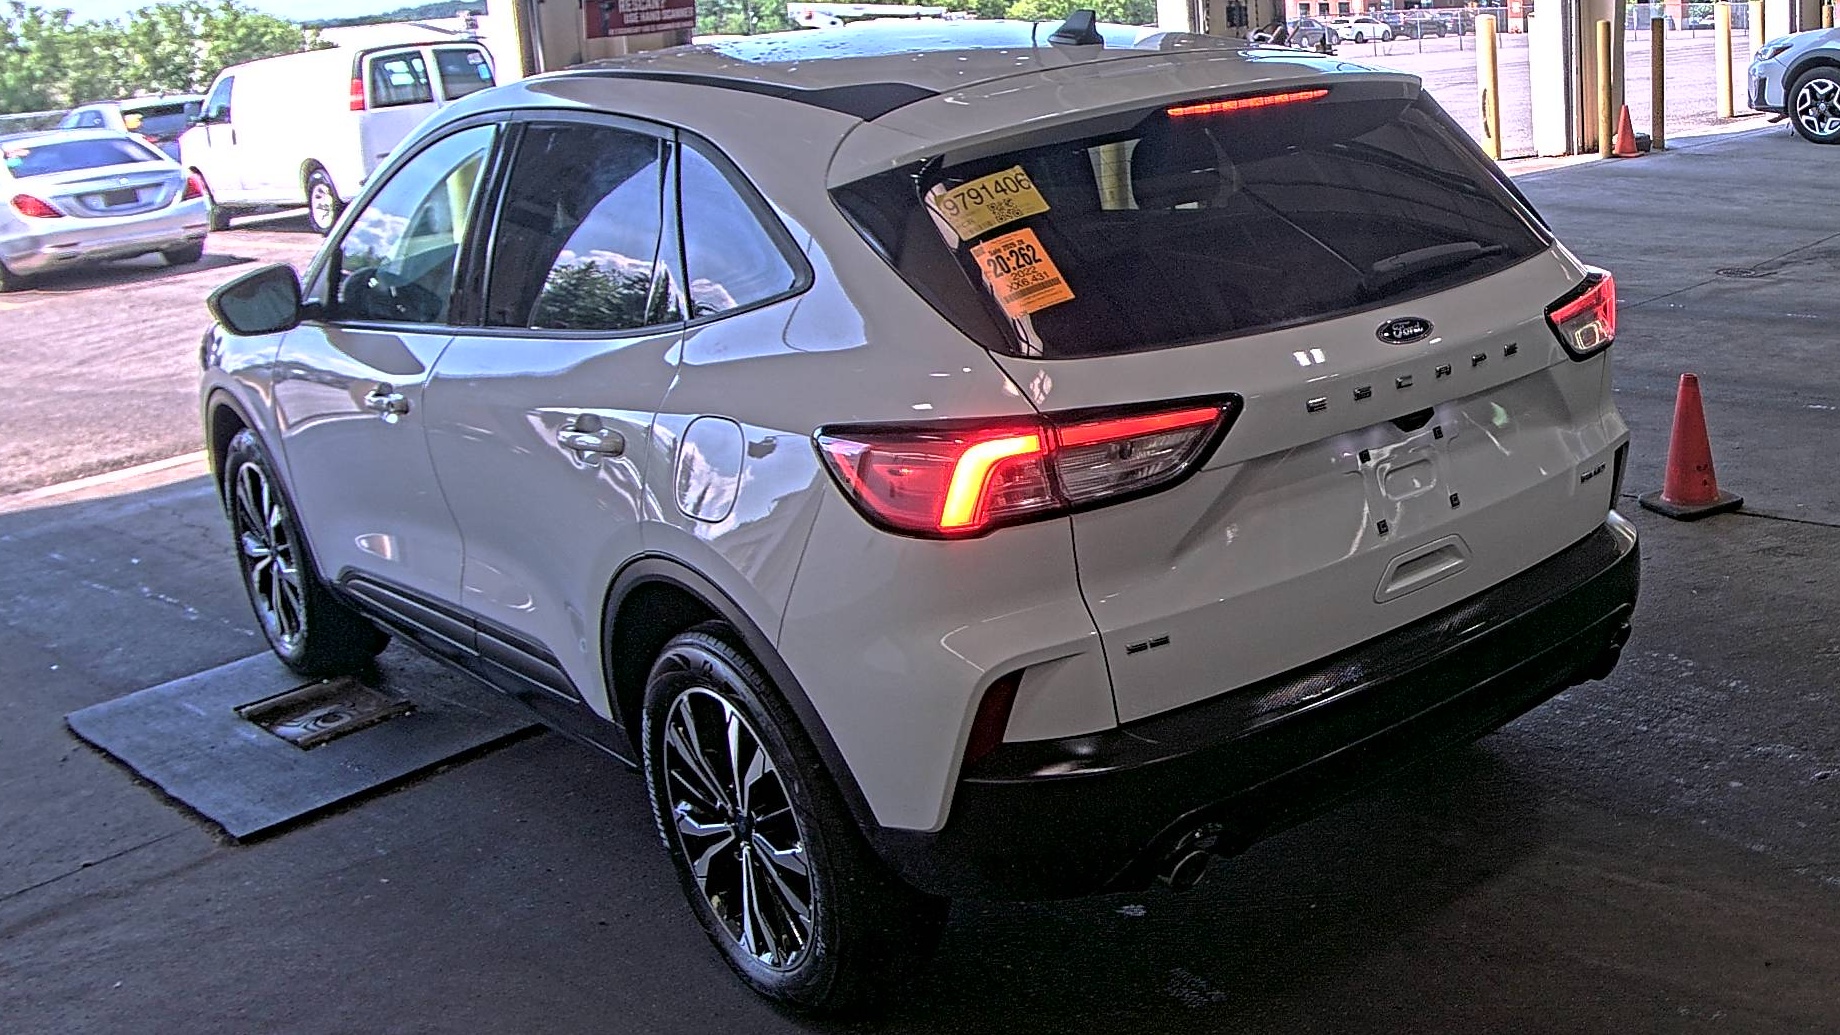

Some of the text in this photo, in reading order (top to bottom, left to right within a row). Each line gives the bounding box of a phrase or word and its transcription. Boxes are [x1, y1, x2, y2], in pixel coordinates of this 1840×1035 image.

[943, 172, 1032, 217] 9791406
[1010, 266, 1038, 281] 2022
[1391, 320, 1424, 338] Ford
[1306, 342, 1519, 413] ESCAPE
